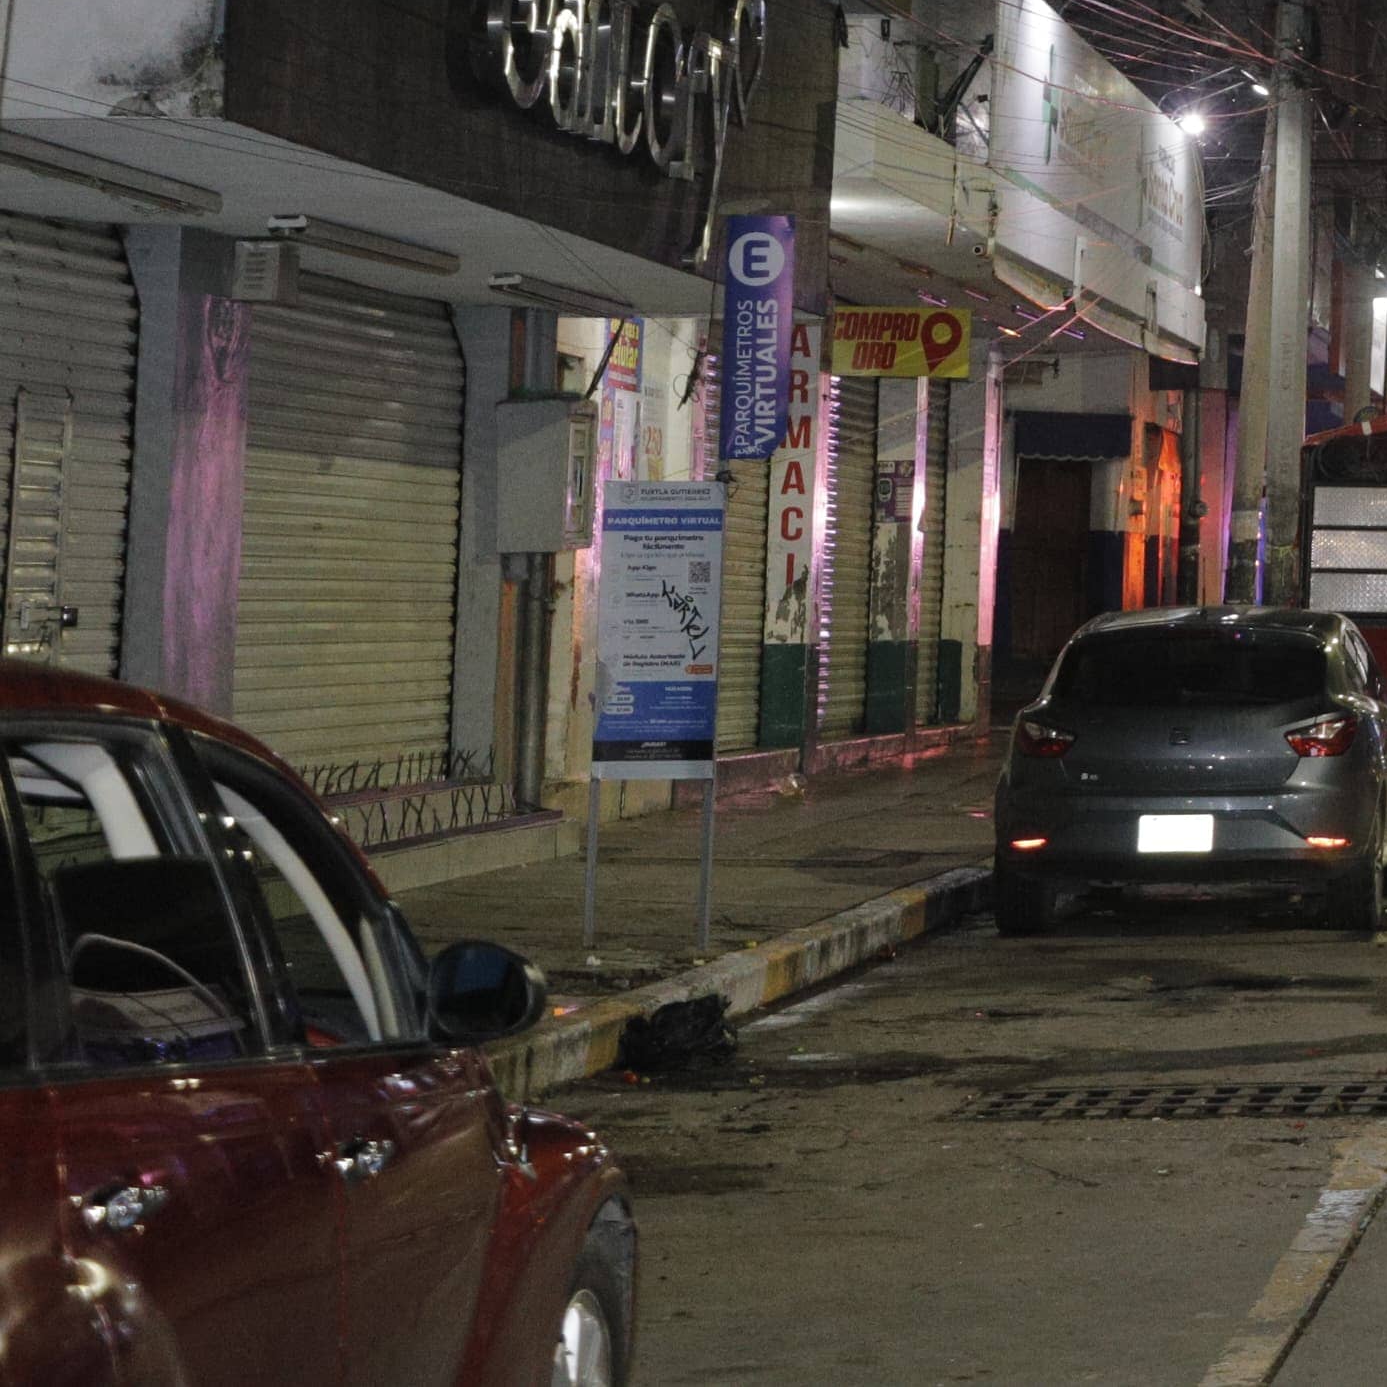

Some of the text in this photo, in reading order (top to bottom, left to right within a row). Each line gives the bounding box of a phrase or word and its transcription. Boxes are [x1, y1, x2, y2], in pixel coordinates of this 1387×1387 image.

[834, 312, 920, 342] COMPRO
[851, 341, 897, 370] ORO
[735, 300, 753, 446] PARQUÍMETROS
[755, 298, 779, 450] VIRTUALES
[607, 516, 720, 526] PARQUÍMETRO VIRTUAL
